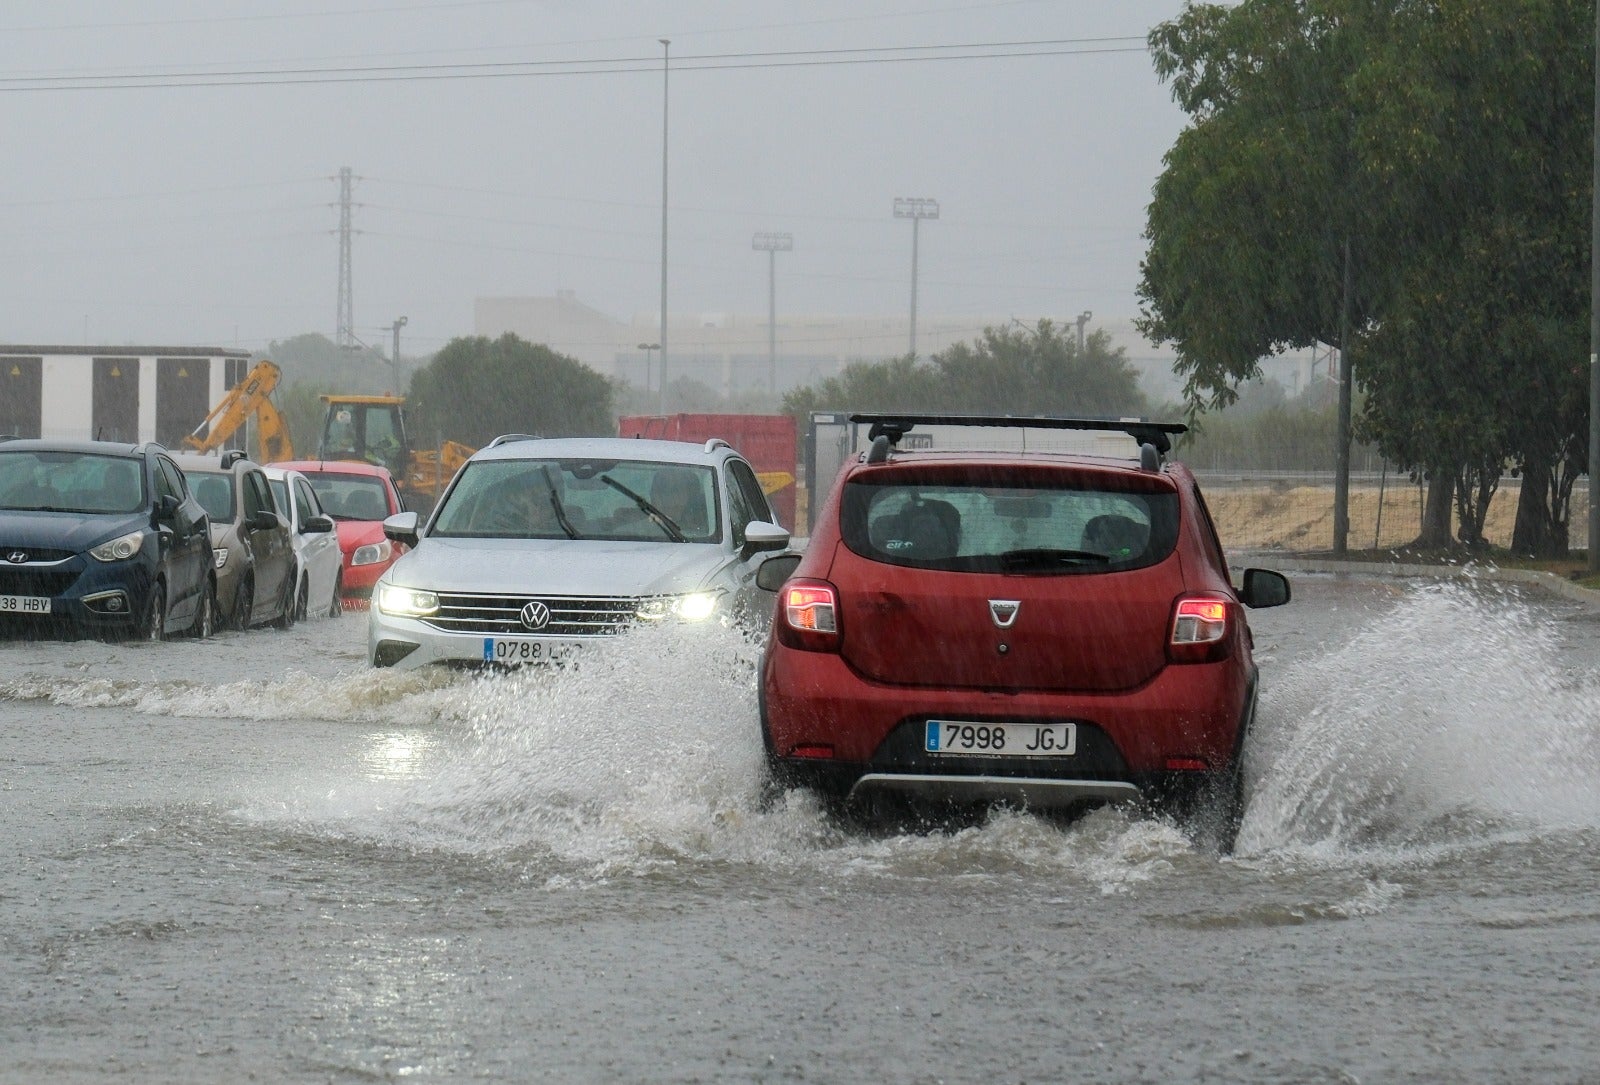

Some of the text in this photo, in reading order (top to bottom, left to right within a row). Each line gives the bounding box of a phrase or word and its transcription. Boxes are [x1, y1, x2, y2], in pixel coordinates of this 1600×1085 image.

[23, 598, 48, 611] HBV
[496, 641, 542, 659] 0788
[946, 725, 1005, 749] 7998
[1026, 727, 1069, 750] JGJ
